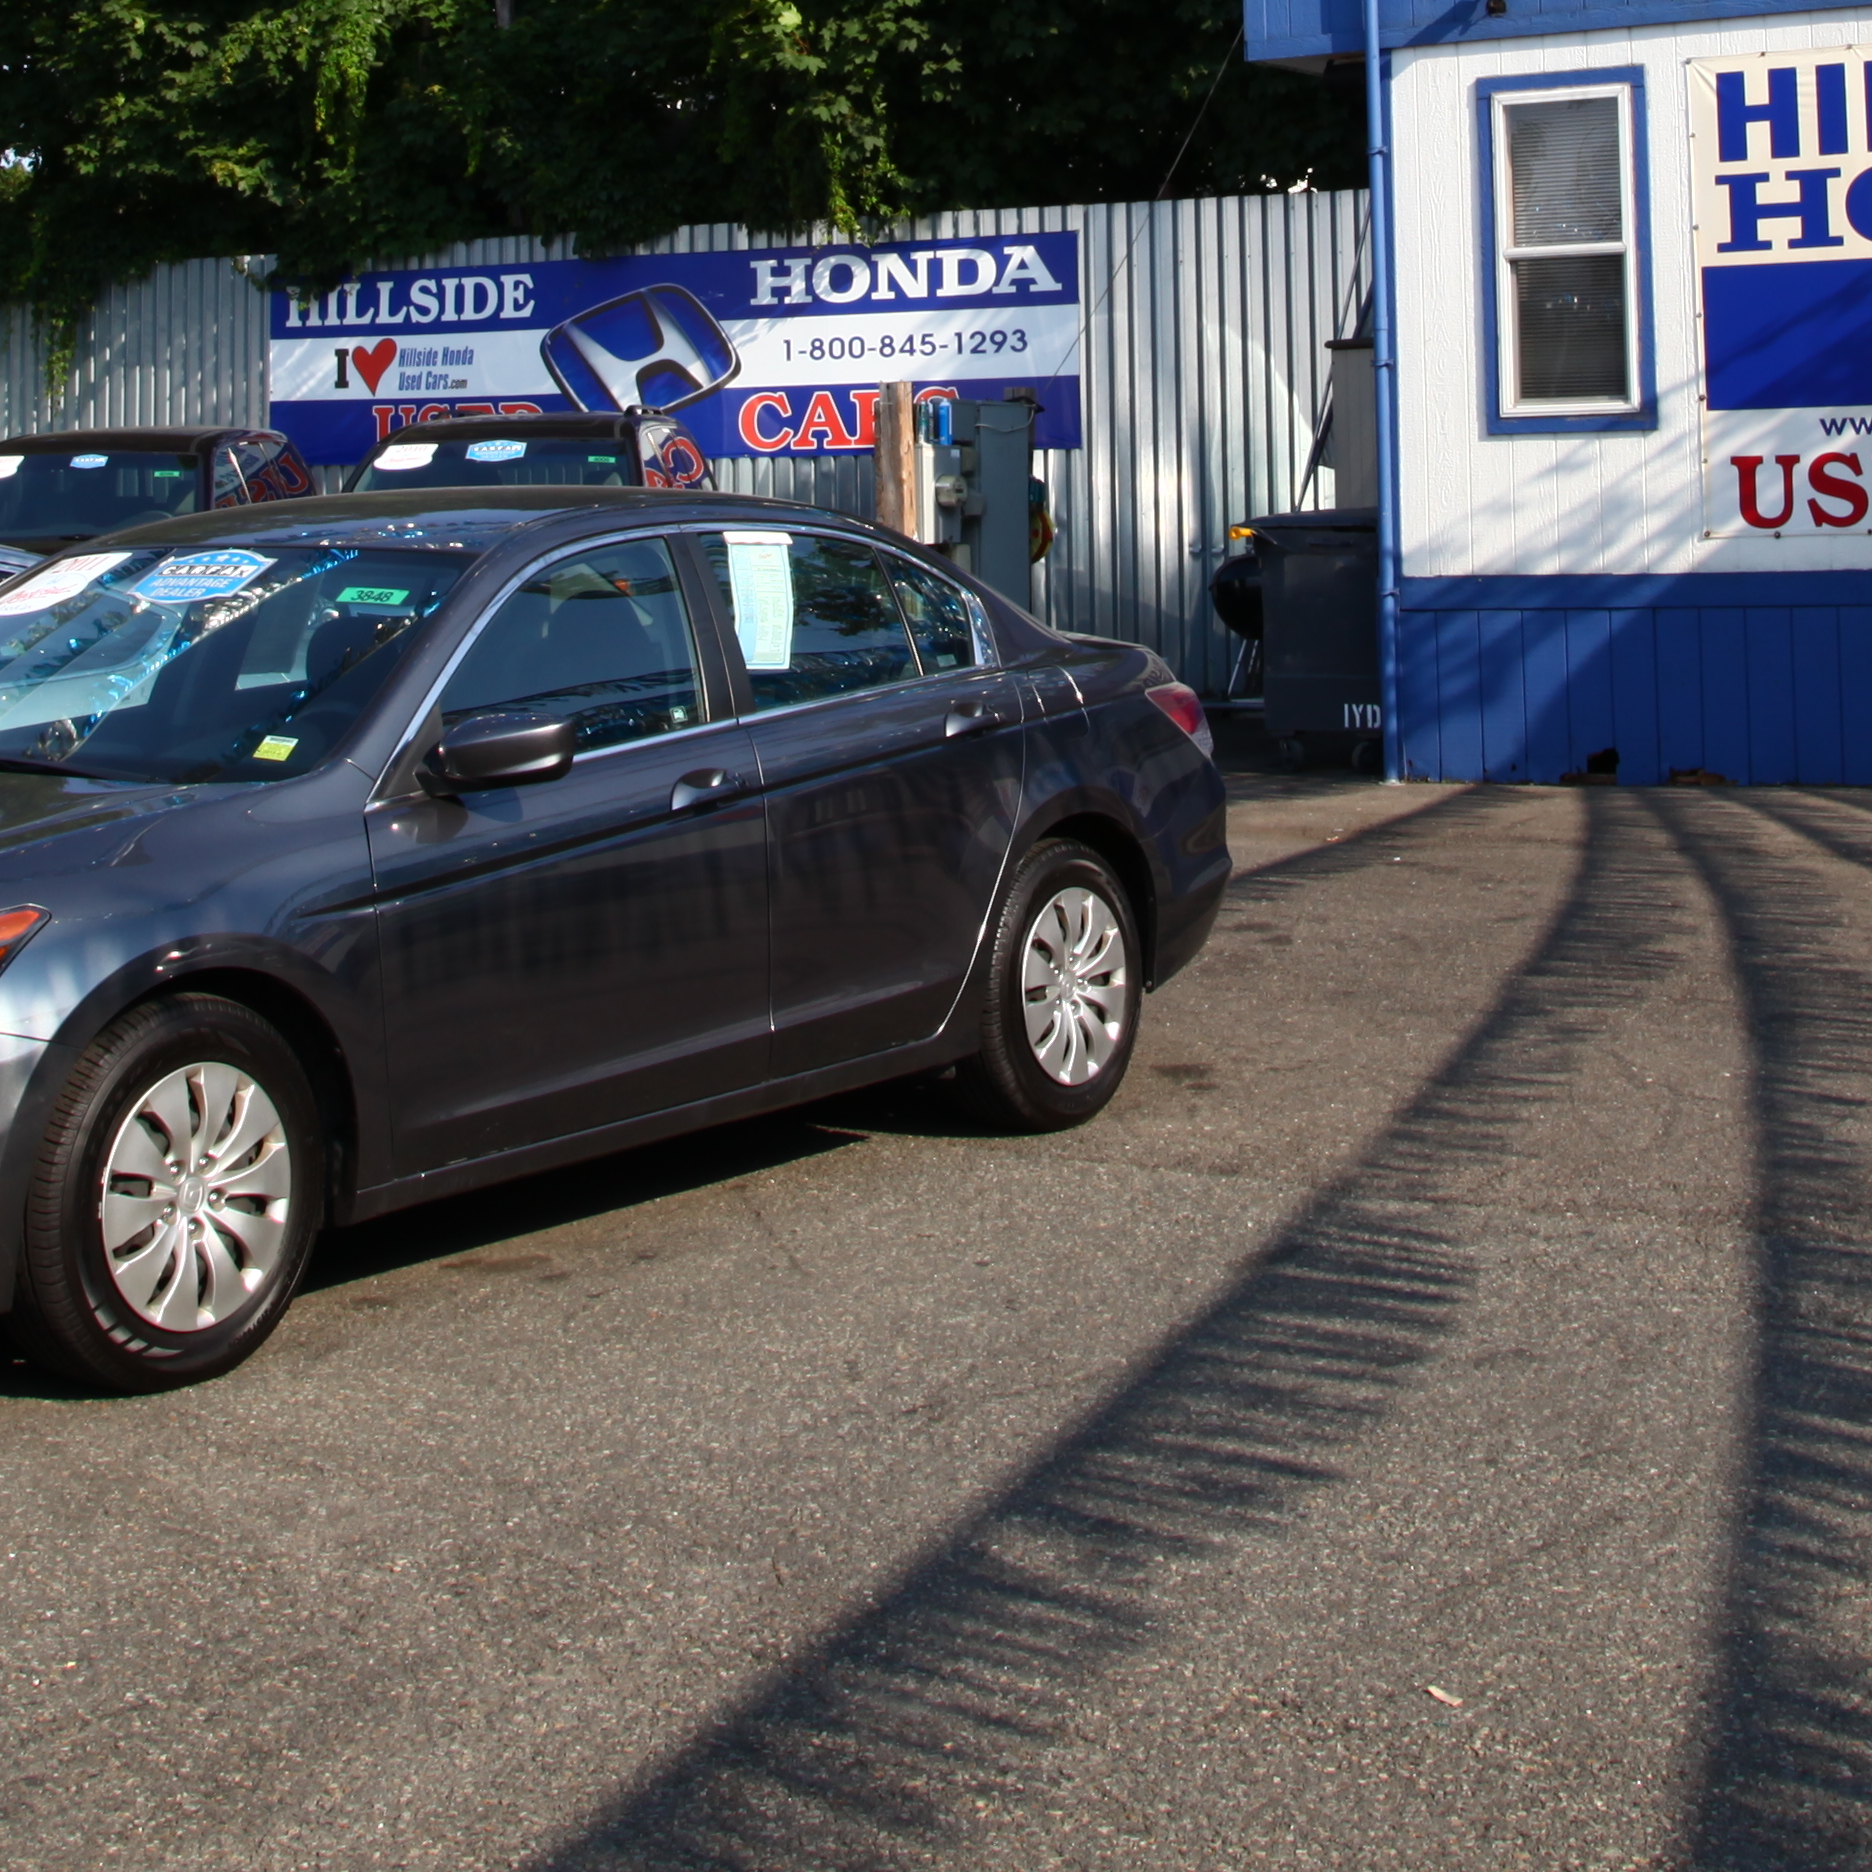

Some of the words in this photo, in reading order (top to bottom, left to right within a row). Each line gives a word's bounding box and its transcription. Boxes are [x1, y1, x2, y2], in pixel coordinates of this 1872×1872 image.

[749, 244, 1062, 306] HONDA
[782, 328, 1029, 362] 1-800-845-1293
[398, 347, 438, 368] Hillside
[441, 345, 475, 366] Honda
[334, 348, 350, 389] I
[398, 371, 424, 391] Used
[160, 564, 259, 578] CARFAX
[149, 577, 234, 589] ADVANTAGE
[150, 587, 206, 598] DEALER
[350, 590, 395, 603] 3848
